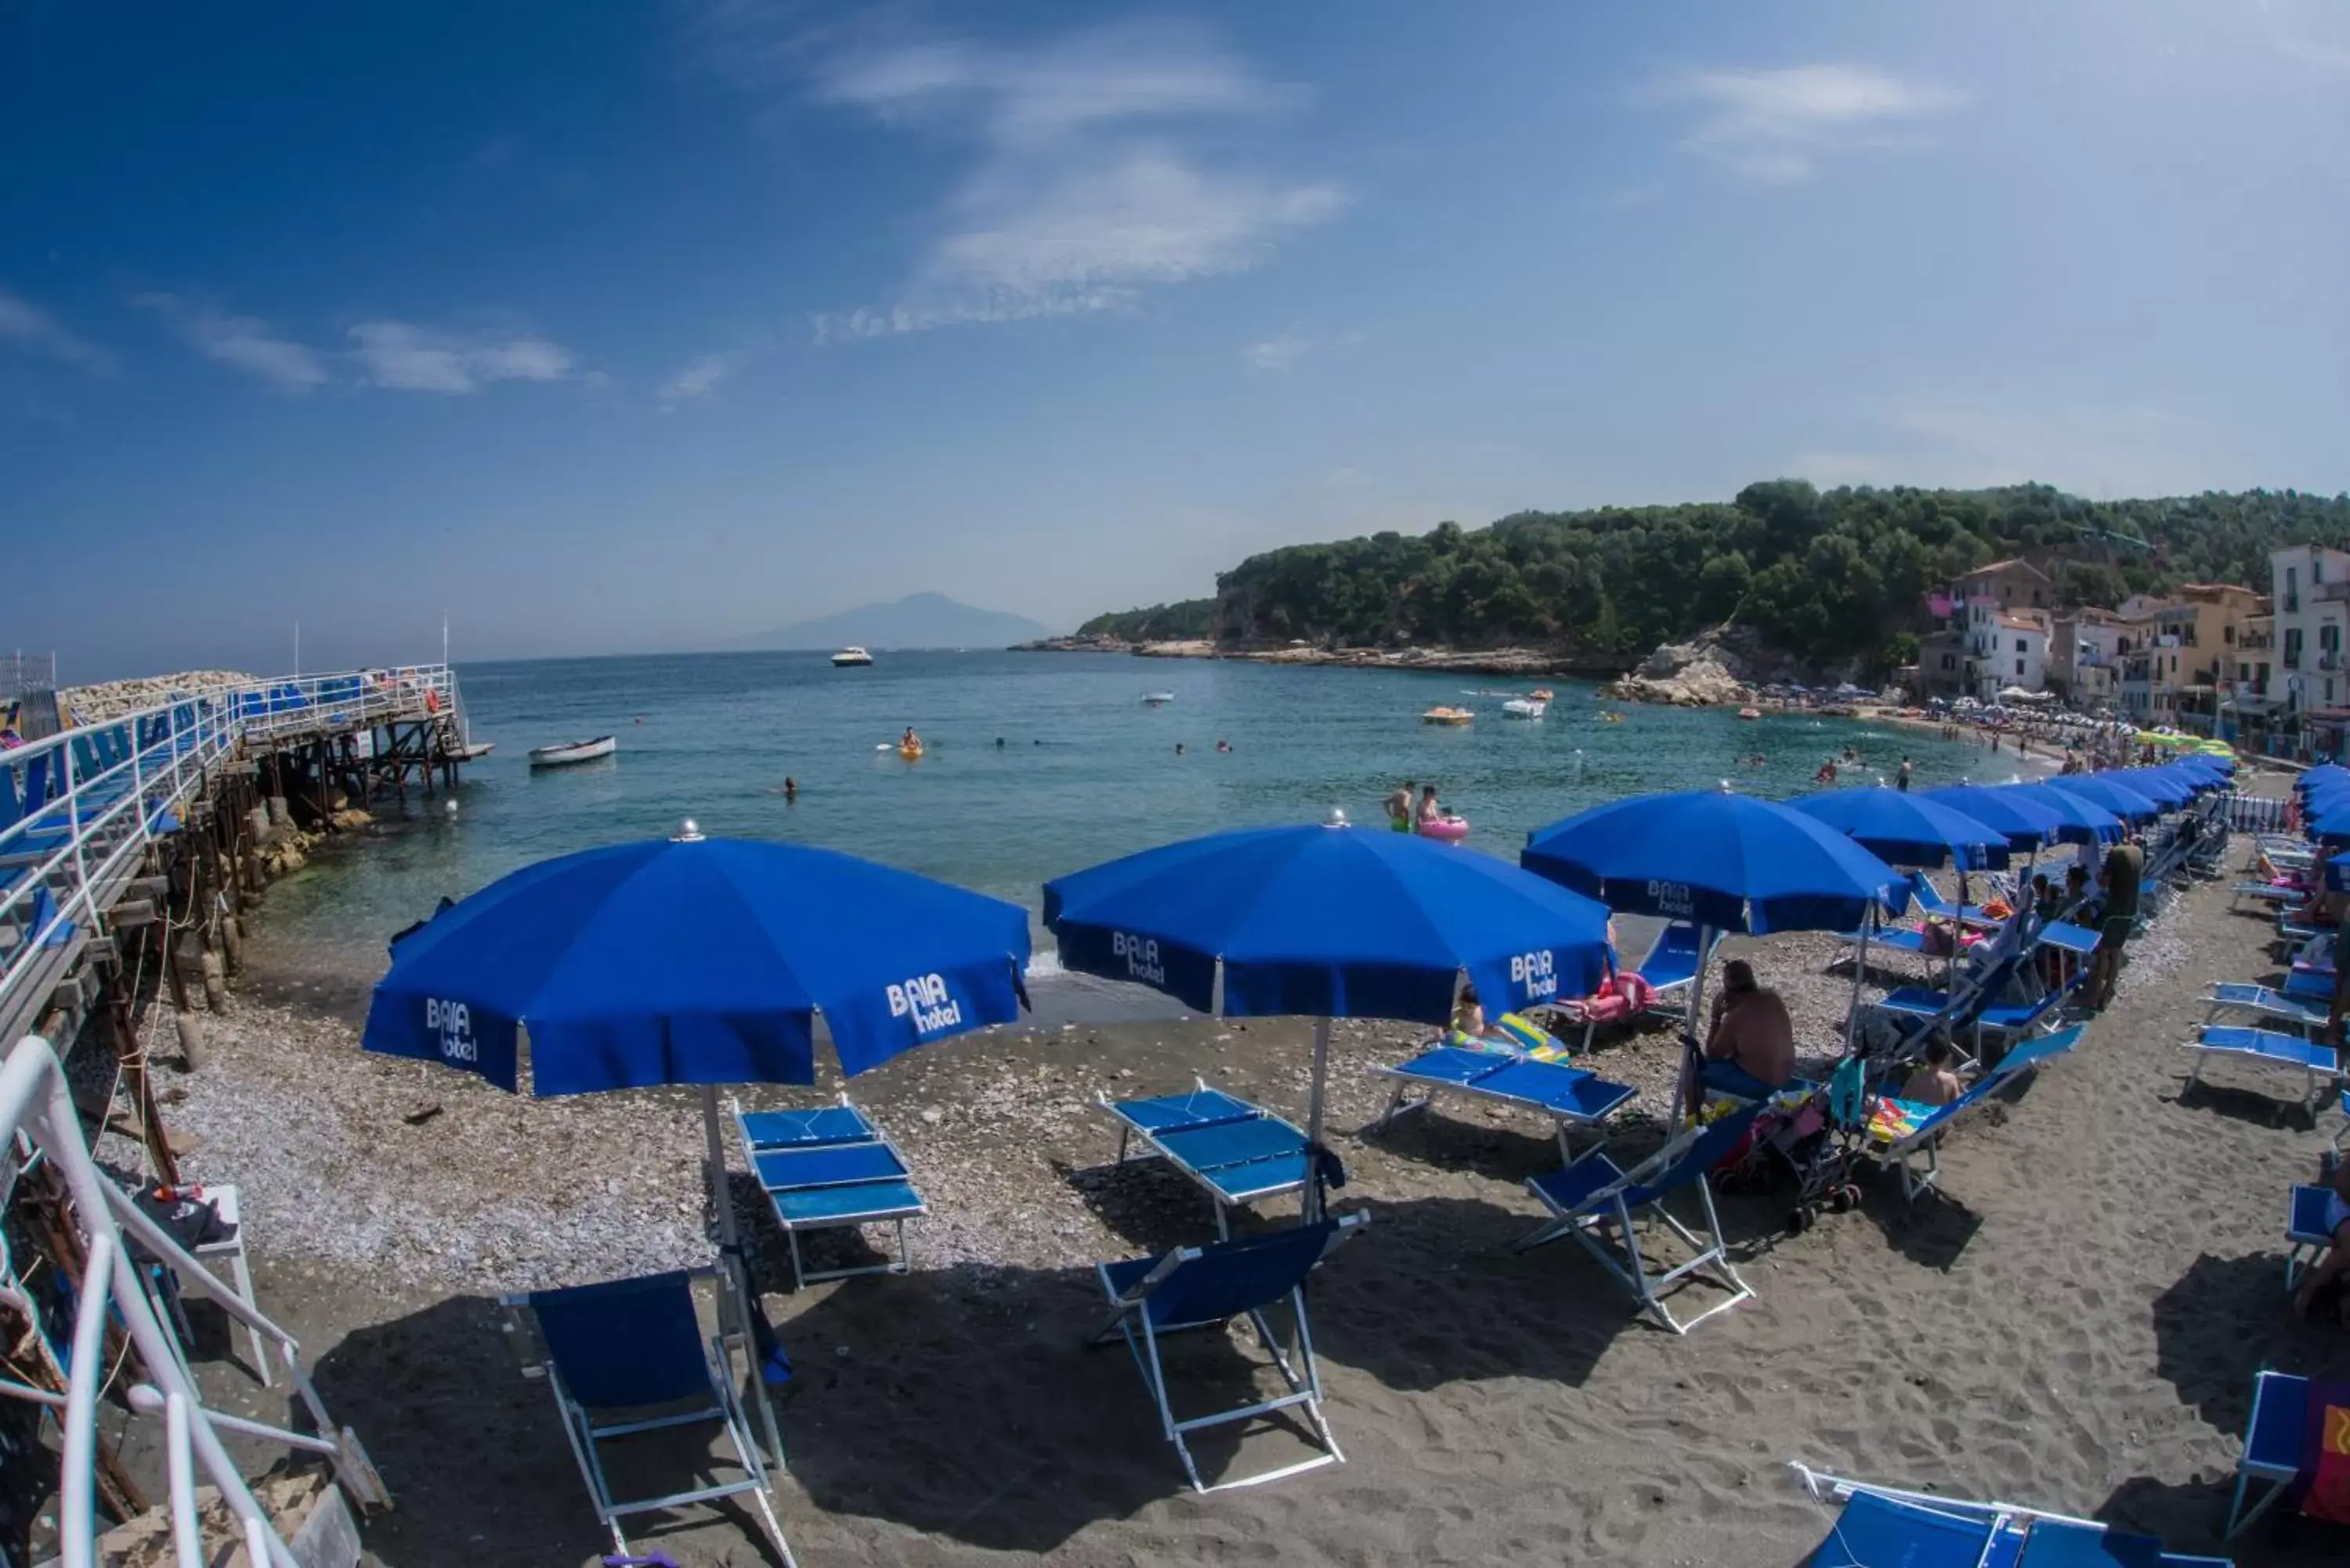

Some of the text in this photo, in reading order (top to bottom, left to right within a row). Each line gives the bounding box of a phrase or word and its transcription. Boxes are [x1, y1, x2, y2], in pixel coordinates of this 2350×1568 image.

[1113, 930, 1158, 964] BAIA
[1129, 960, 1165, 985] hotel
[1511, 949, 1553, 982] BAIA
[886, 973, 948, 1017] BAIA
[427, 997, 471, 1035] BAIA
[911, 999, 961, 1033] hotel
